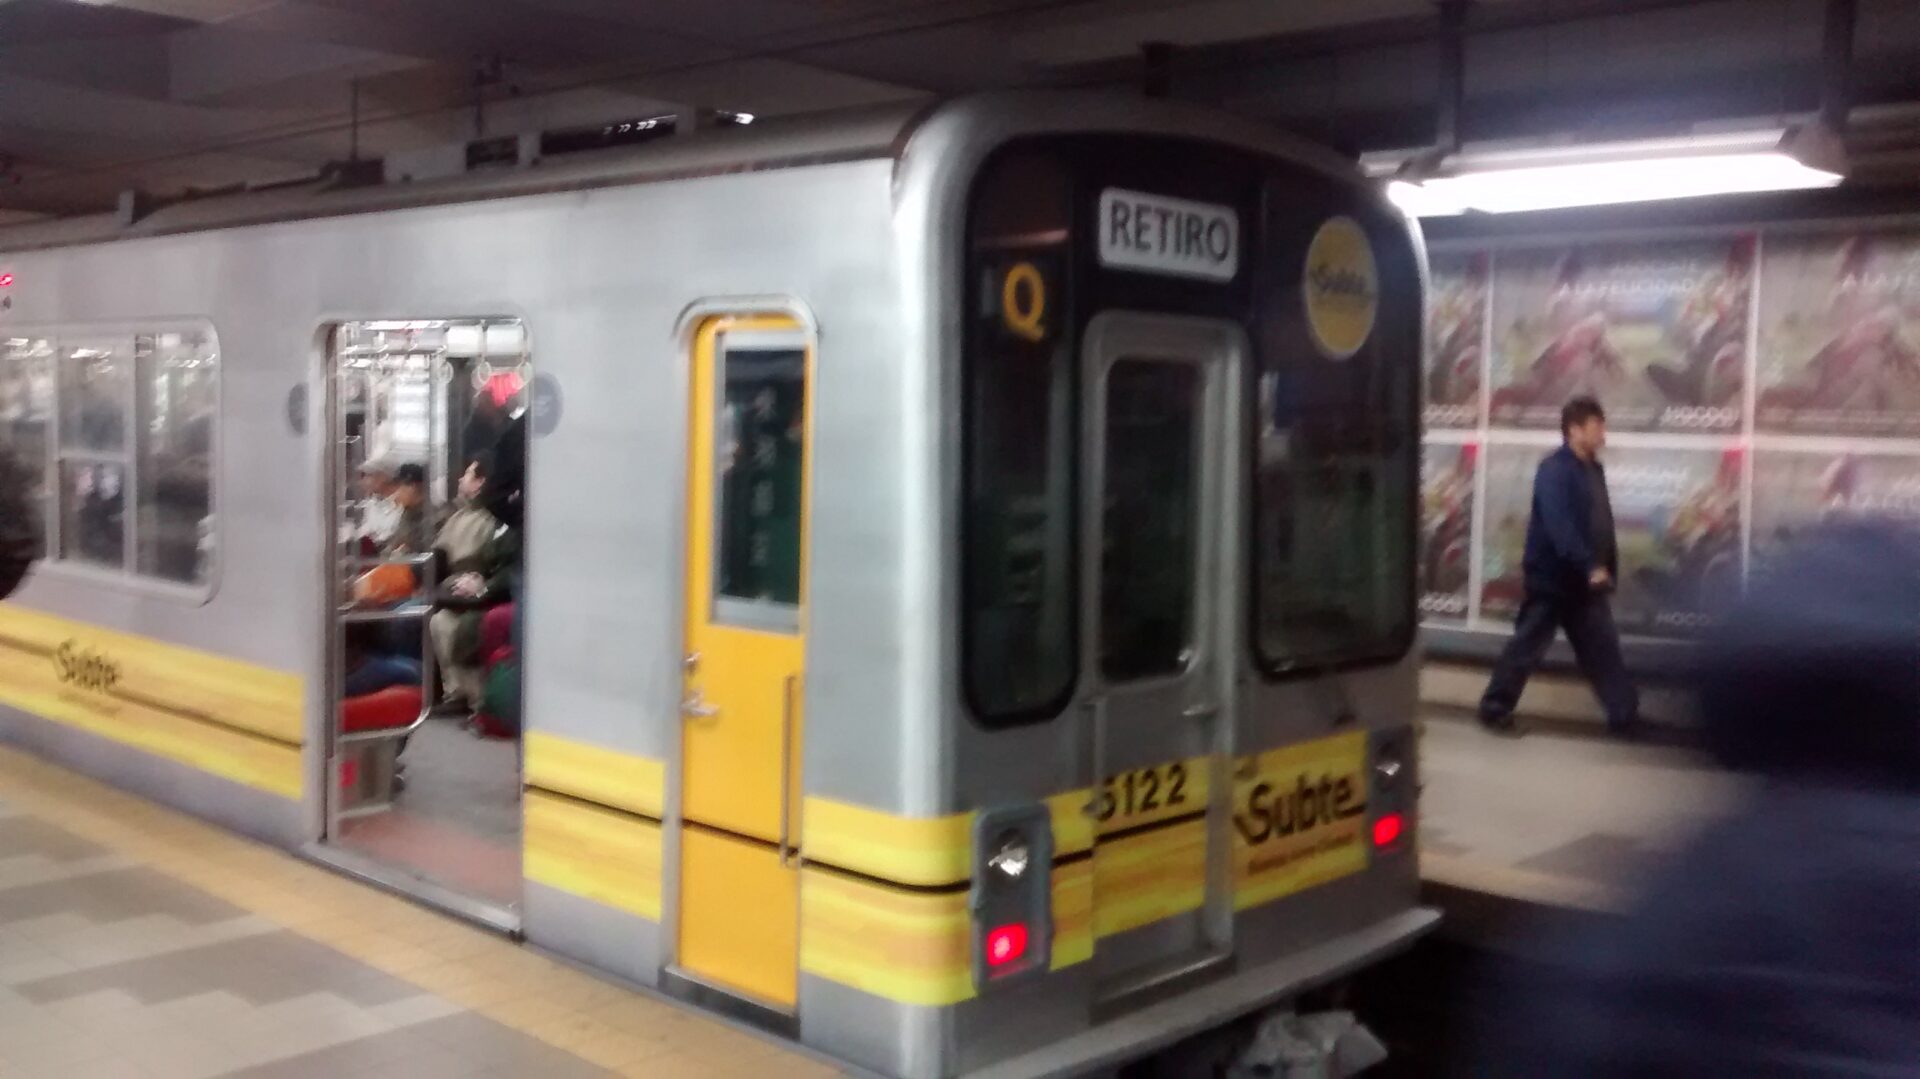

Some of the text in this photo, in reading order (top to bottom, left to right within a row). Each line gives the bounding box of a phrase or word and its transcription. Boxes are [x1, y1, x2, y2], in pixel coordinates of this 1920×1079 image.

[1109, 199, 1231, 263] RETIRO
[1003, 262, 1046, 342] Q
[1232, 772, 1365, 846] Subte
